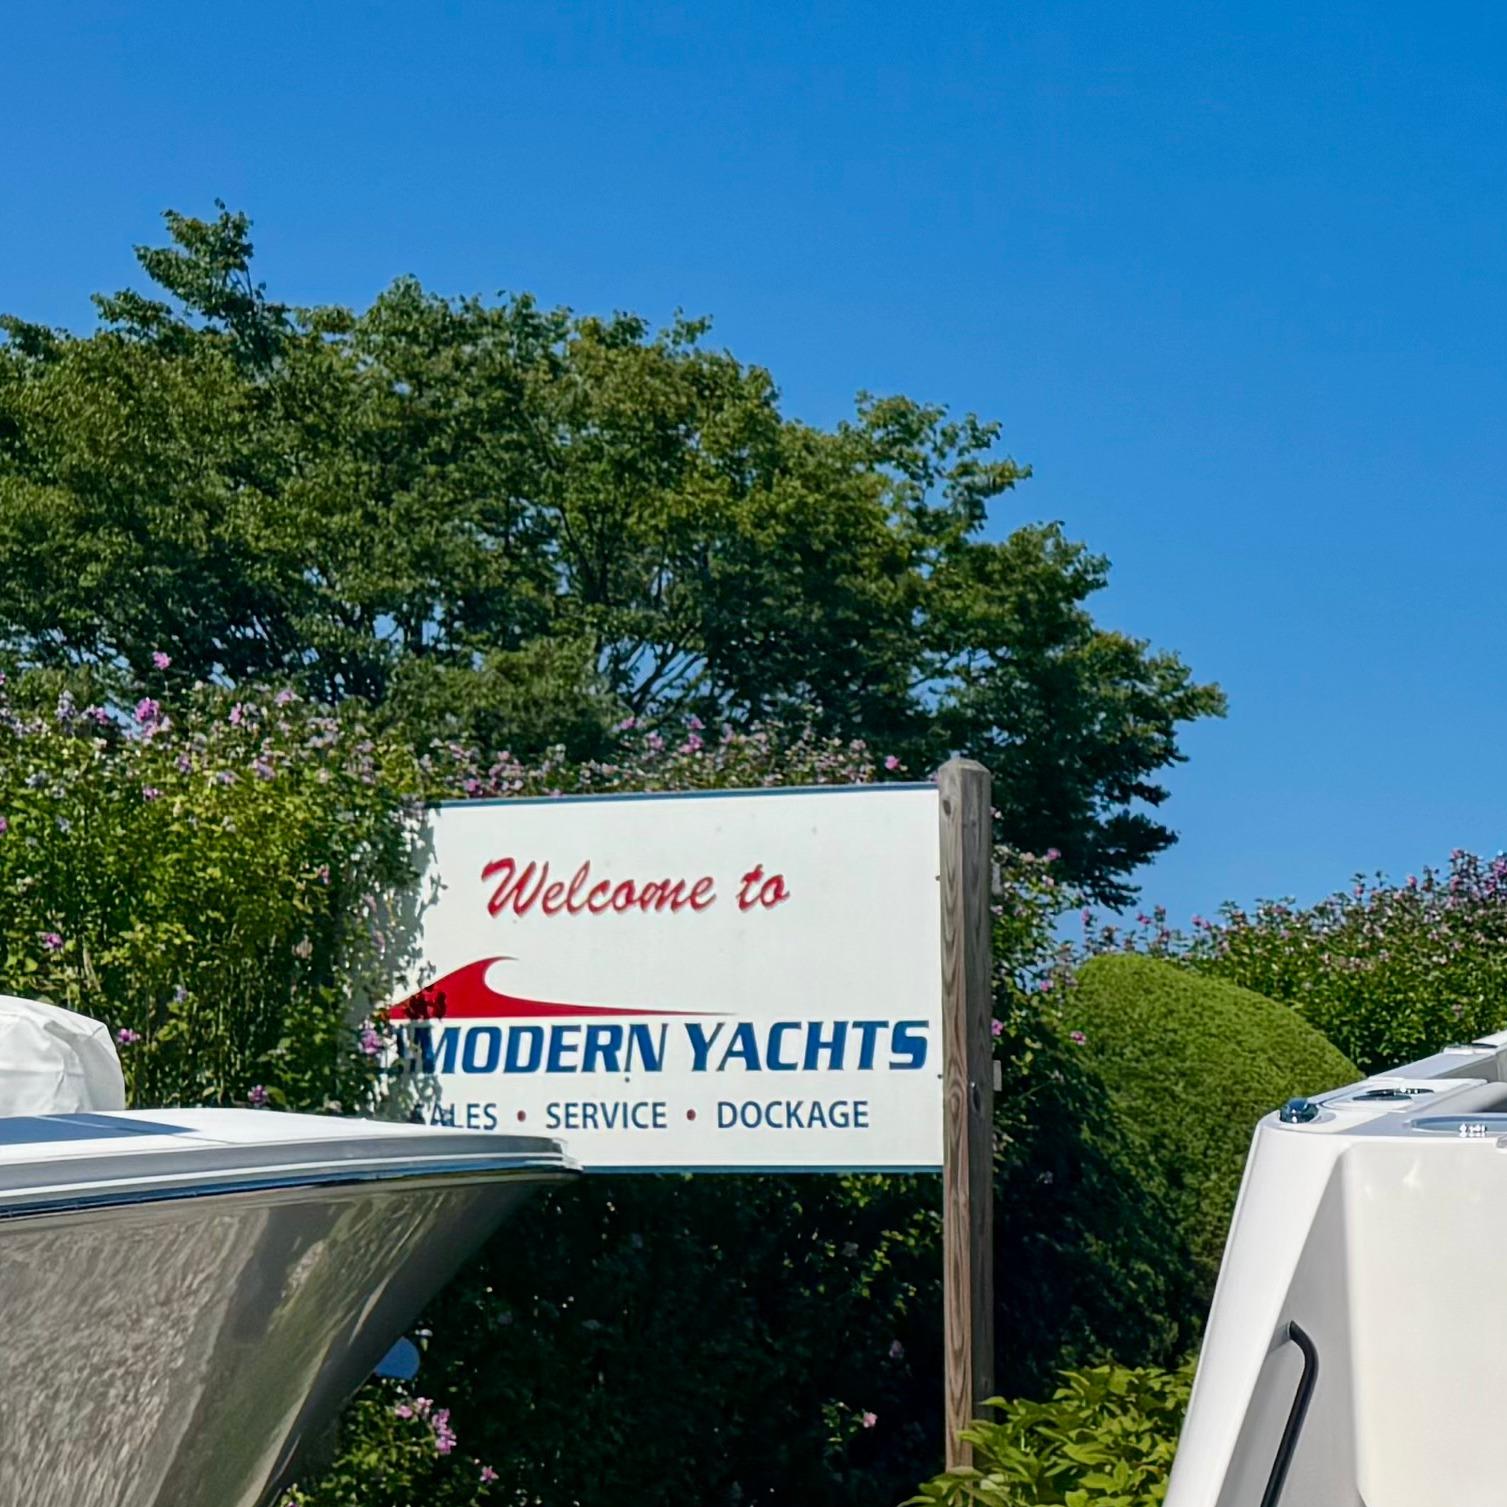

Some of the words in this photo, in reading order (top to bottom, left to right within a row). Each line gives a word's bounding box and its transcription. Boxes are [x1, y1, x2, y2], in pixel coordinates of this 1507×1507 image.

[480, 857, 717, 918] Welcome
[735, 863, 791, 912] to
[400, 1023, 669, 1074] MODERN
[684, 1020, 930, 1072] YACHTS
[545, 1101, 668, 1130] SERVICE
[717, 1100, 870, 1130] DOCKAGE
